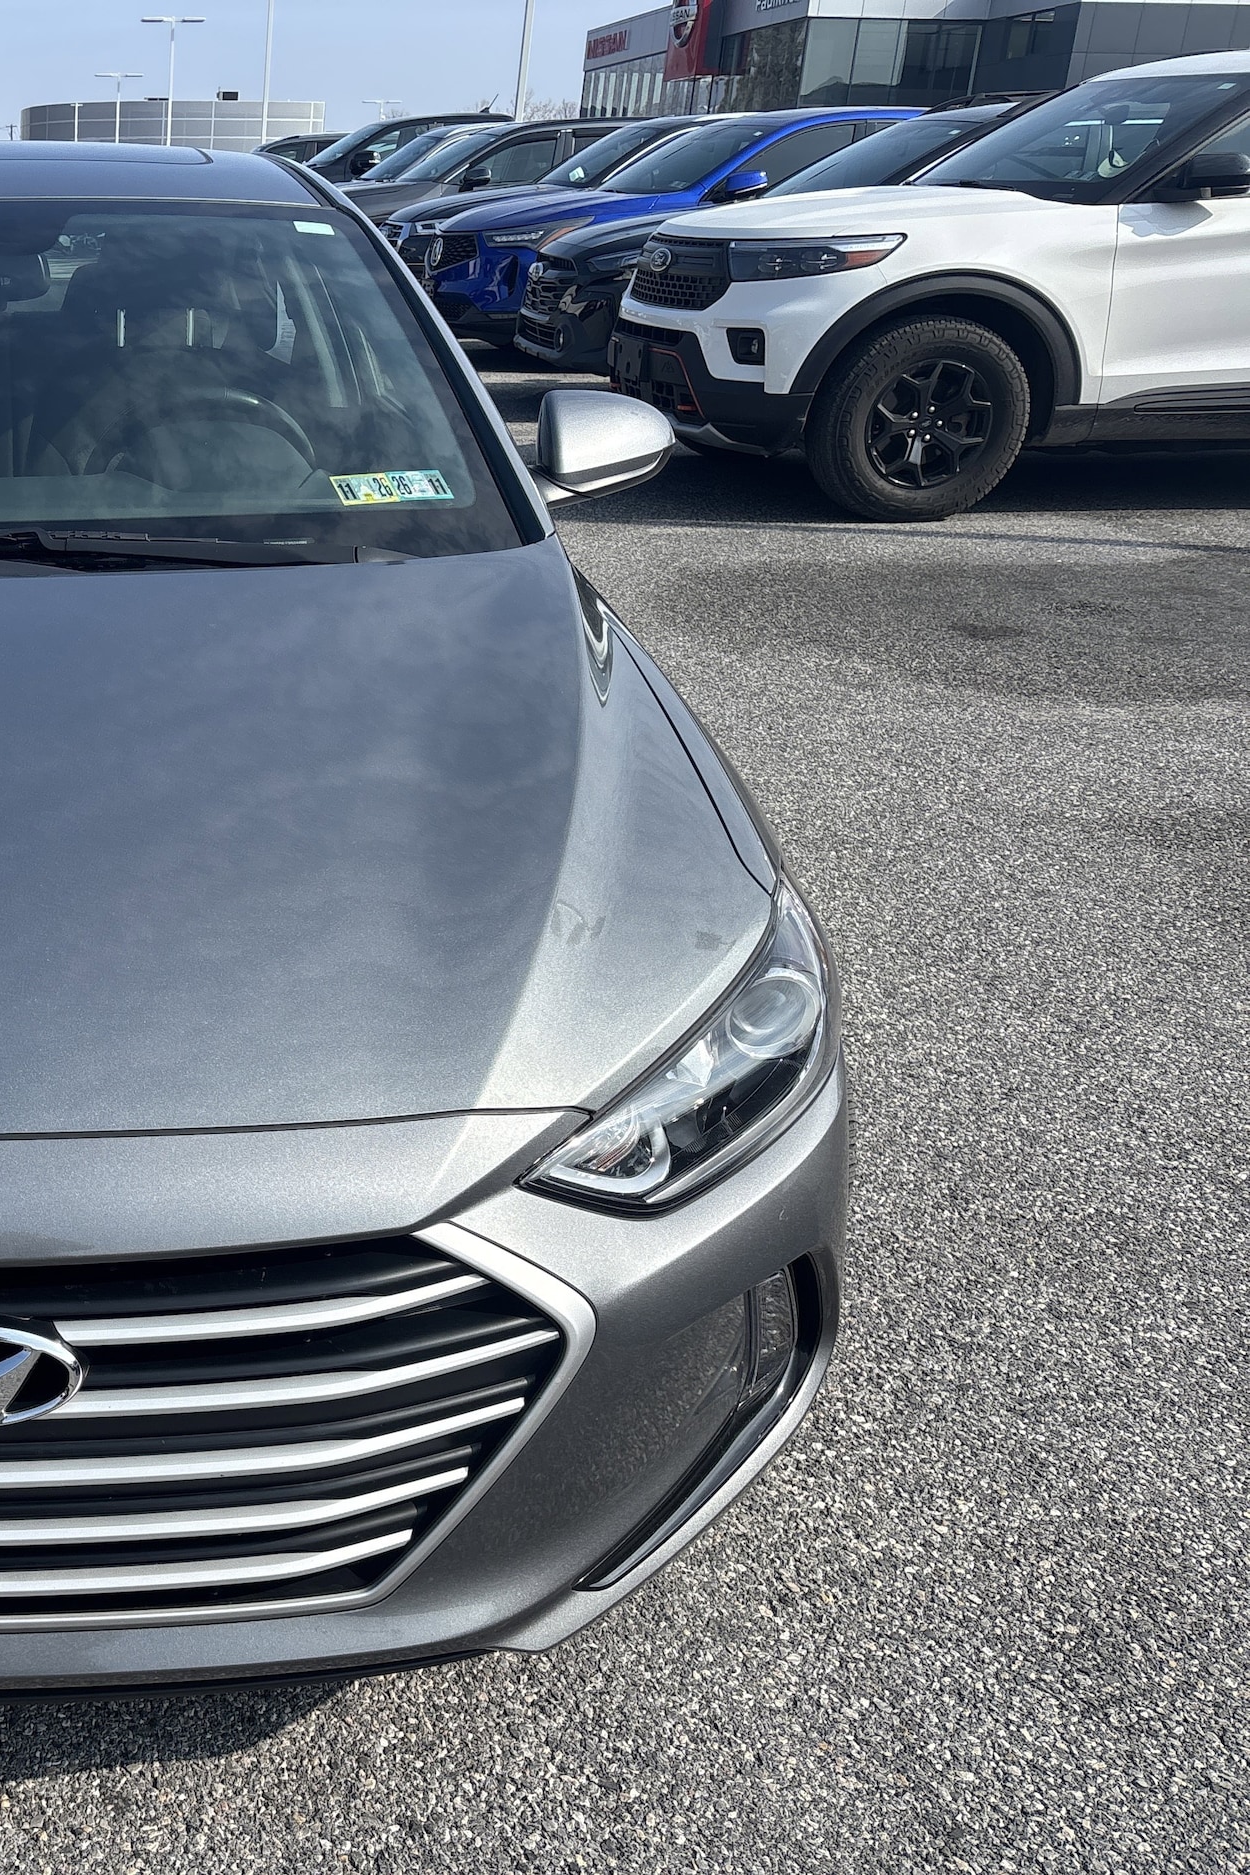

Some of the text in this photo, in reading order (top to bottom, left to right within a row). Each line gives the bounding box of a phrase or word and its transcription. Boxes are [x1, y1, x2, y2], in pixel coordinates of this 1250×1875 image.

[587, 29, 628, 59] NISSAN
[337, 477, 393, 501] 11 26
[392, 475, 448, 495] 26 11
